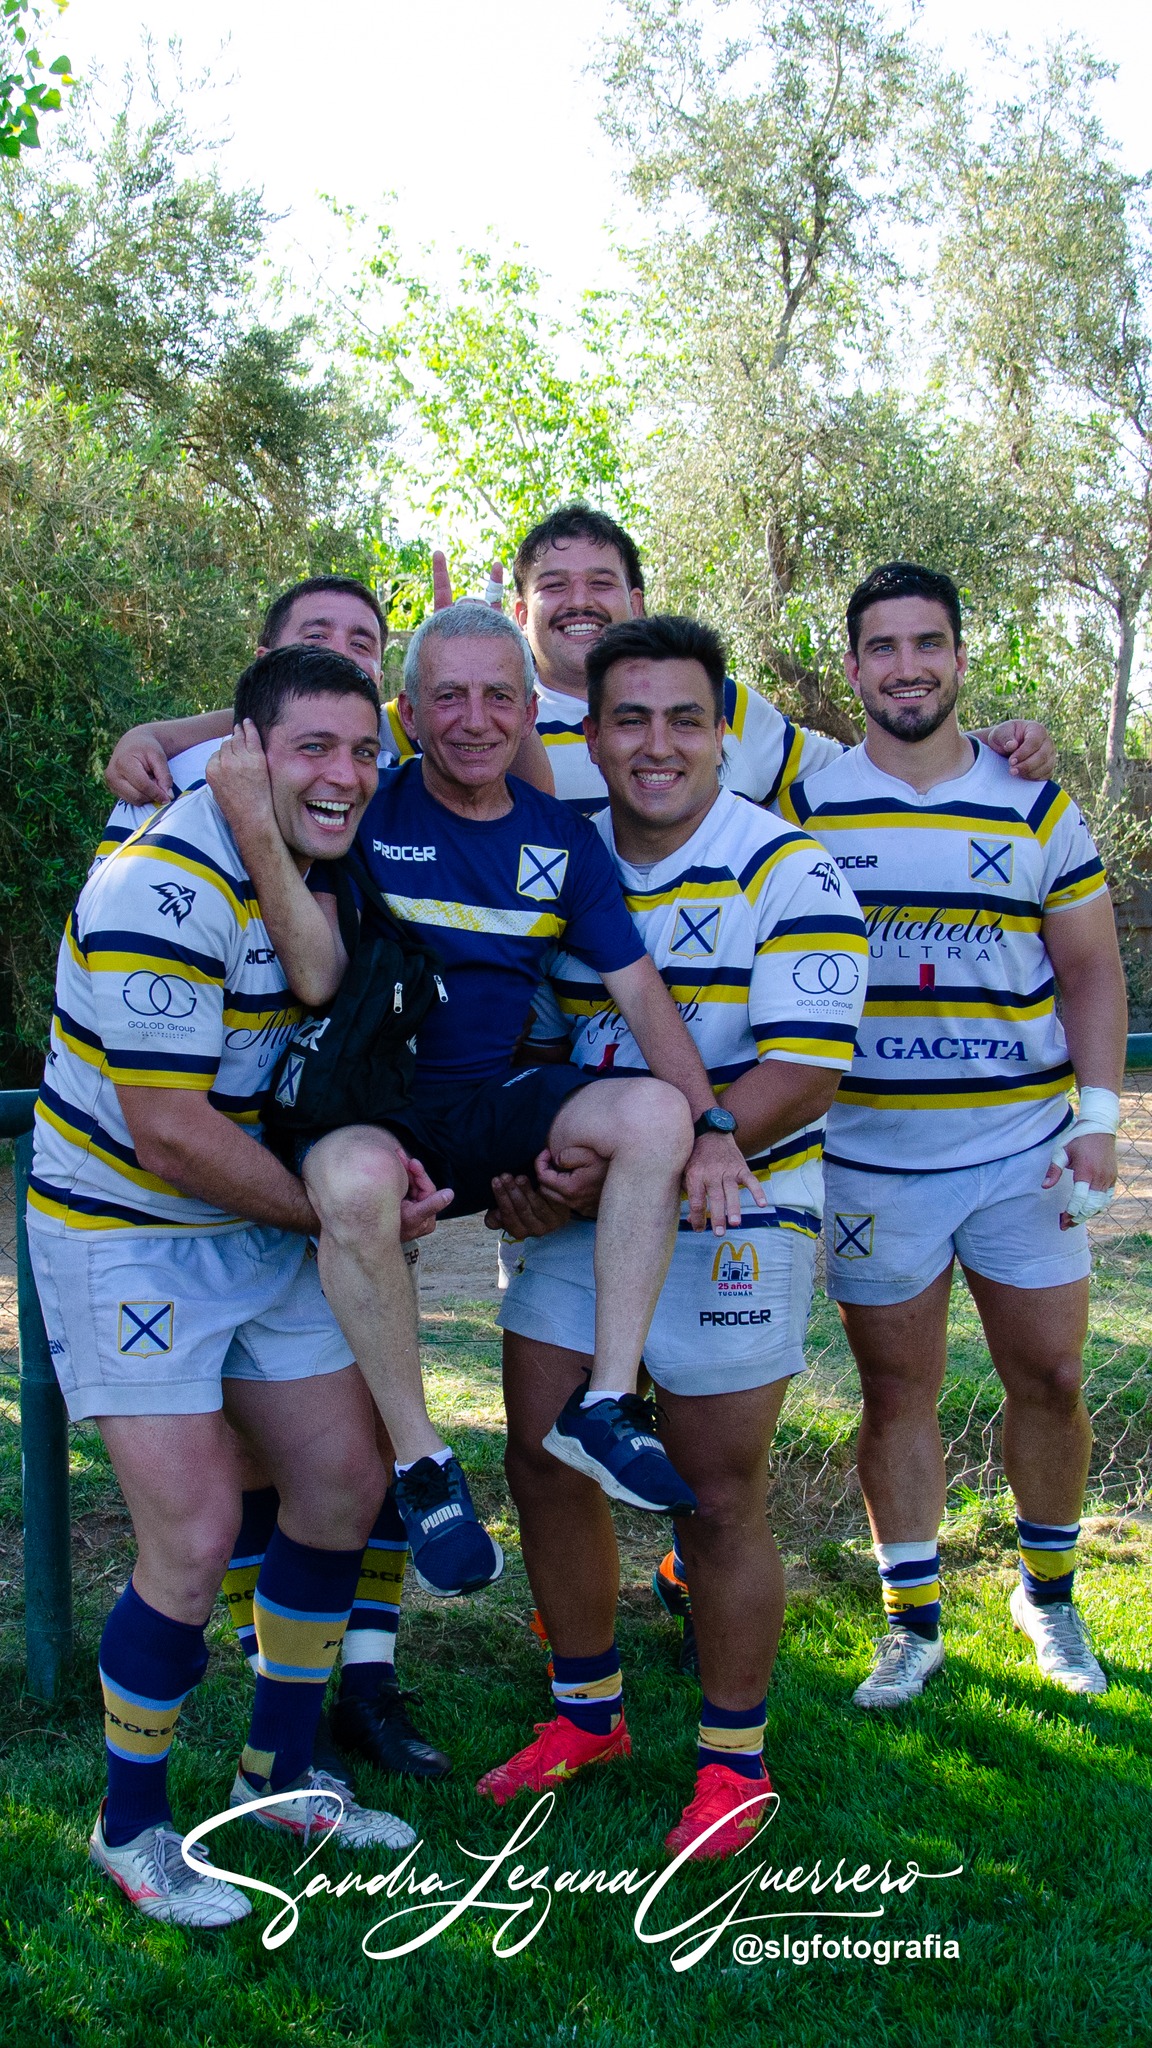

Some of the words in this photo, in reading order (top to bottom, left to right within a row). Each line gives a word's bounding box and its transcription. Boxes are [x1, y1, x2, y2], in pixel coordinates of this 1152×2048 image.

[373, 838, 437, 862] PROCER
[833, 855, 879, 870] OCER
[869, 944, 992, 963] ULTRA
[796, 999, 831, 1008] GOLOD
[831, 999, 854, 1010] Group
[127, 1020, 165, 1030] GOLOD
[167, 1022, 196, 1034] Group
[875, 1036, 1029, 1062] GACETA
[717, 1282, 729, 1290] 25
[730, 1281, 753, 1290] años
[699, 1308, 773, 1327] PROCER
[420, 1503, 464, 1535] PUMA
